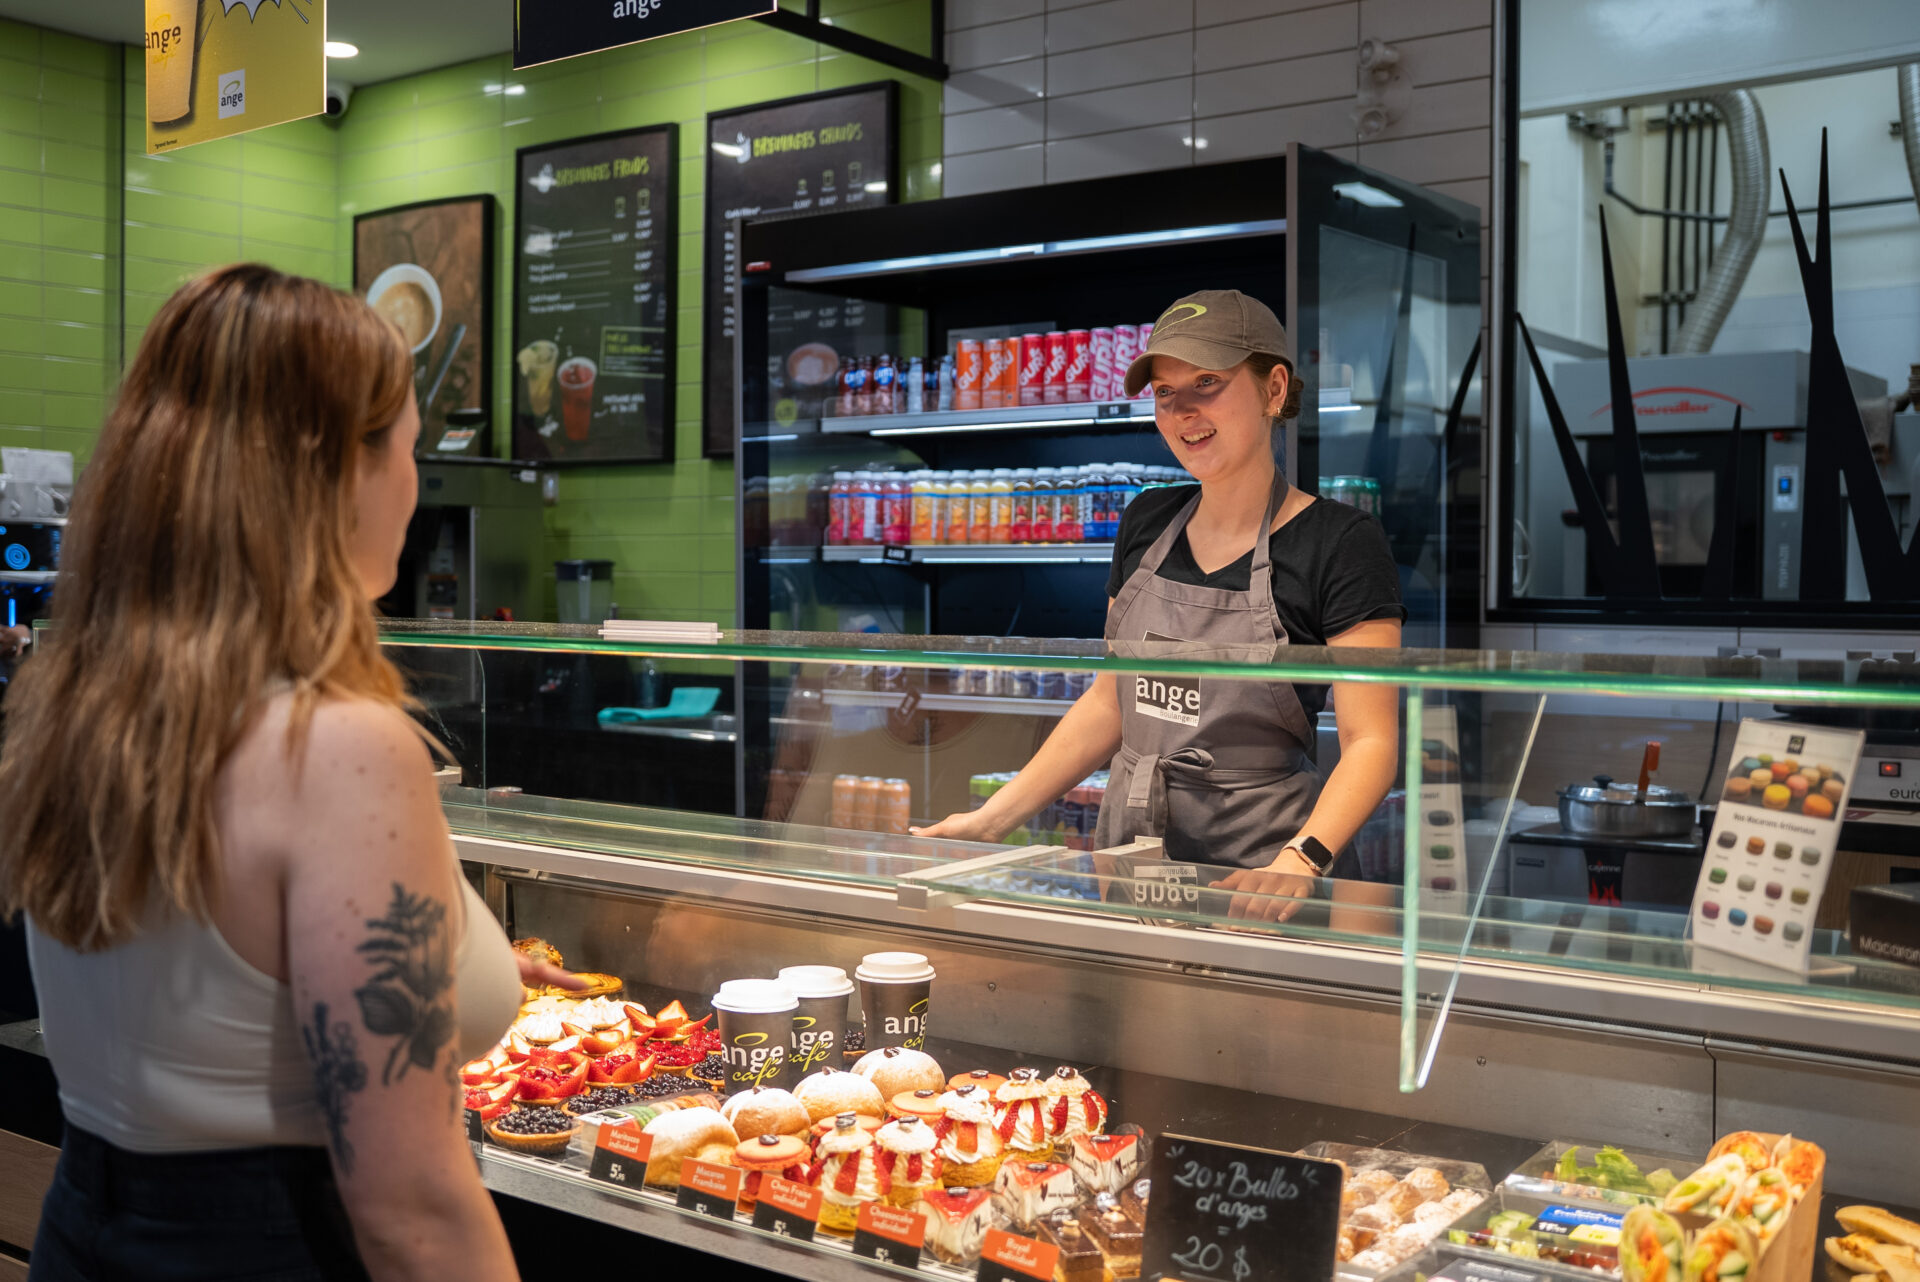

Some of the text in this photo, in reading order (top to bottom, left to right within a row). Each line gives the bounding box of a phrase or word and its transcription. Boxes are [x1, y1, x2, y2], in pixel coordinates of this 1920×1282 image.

[220, 92, 243, 107] ange
[1019, 354, 1044, 386] GUR
[1044, 352, 1066, 384] GUR
[1065, 351, 1090, 383] GUR
[1136, 676, 1200, 713] ange
[884, 1012, 928, 1037] ang
[721, 1043, 784, 1073] ange
[732, 1057, 781, 1086] café
[1227, 1161, 1299, 1198] Bulles
[1195, 1192, 1268, 1229] d'anges
[1006, 1237, 1031, 1256] Royal
[1171, 1235, 1224, 1271] 20
